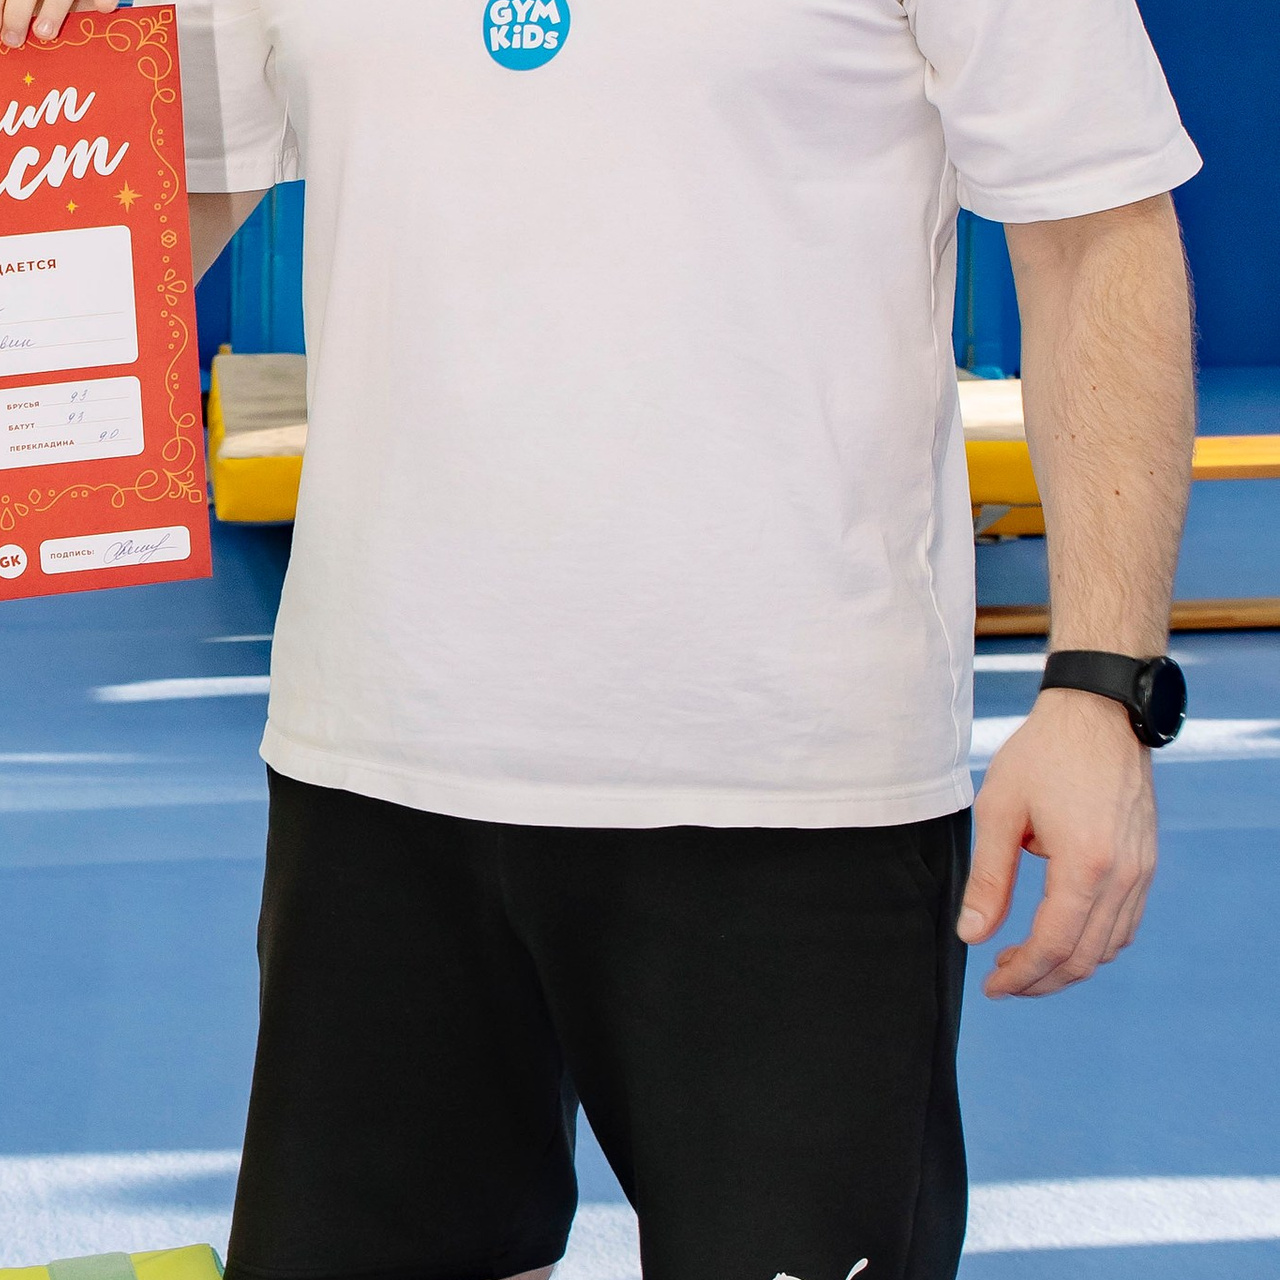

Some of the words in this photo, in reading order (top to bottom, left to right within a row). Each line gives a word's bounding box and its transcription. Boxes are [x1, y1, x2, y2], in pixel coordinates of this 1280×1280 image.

[6, 401, 40, 411] БРУСЬЯ
[8, 422, 35, 431] БАТУТ
[9, 439, 75, 452] ПЕРЕКЛАДИНА
[50, 549, 95, 560] ПОДПИСЬ:
